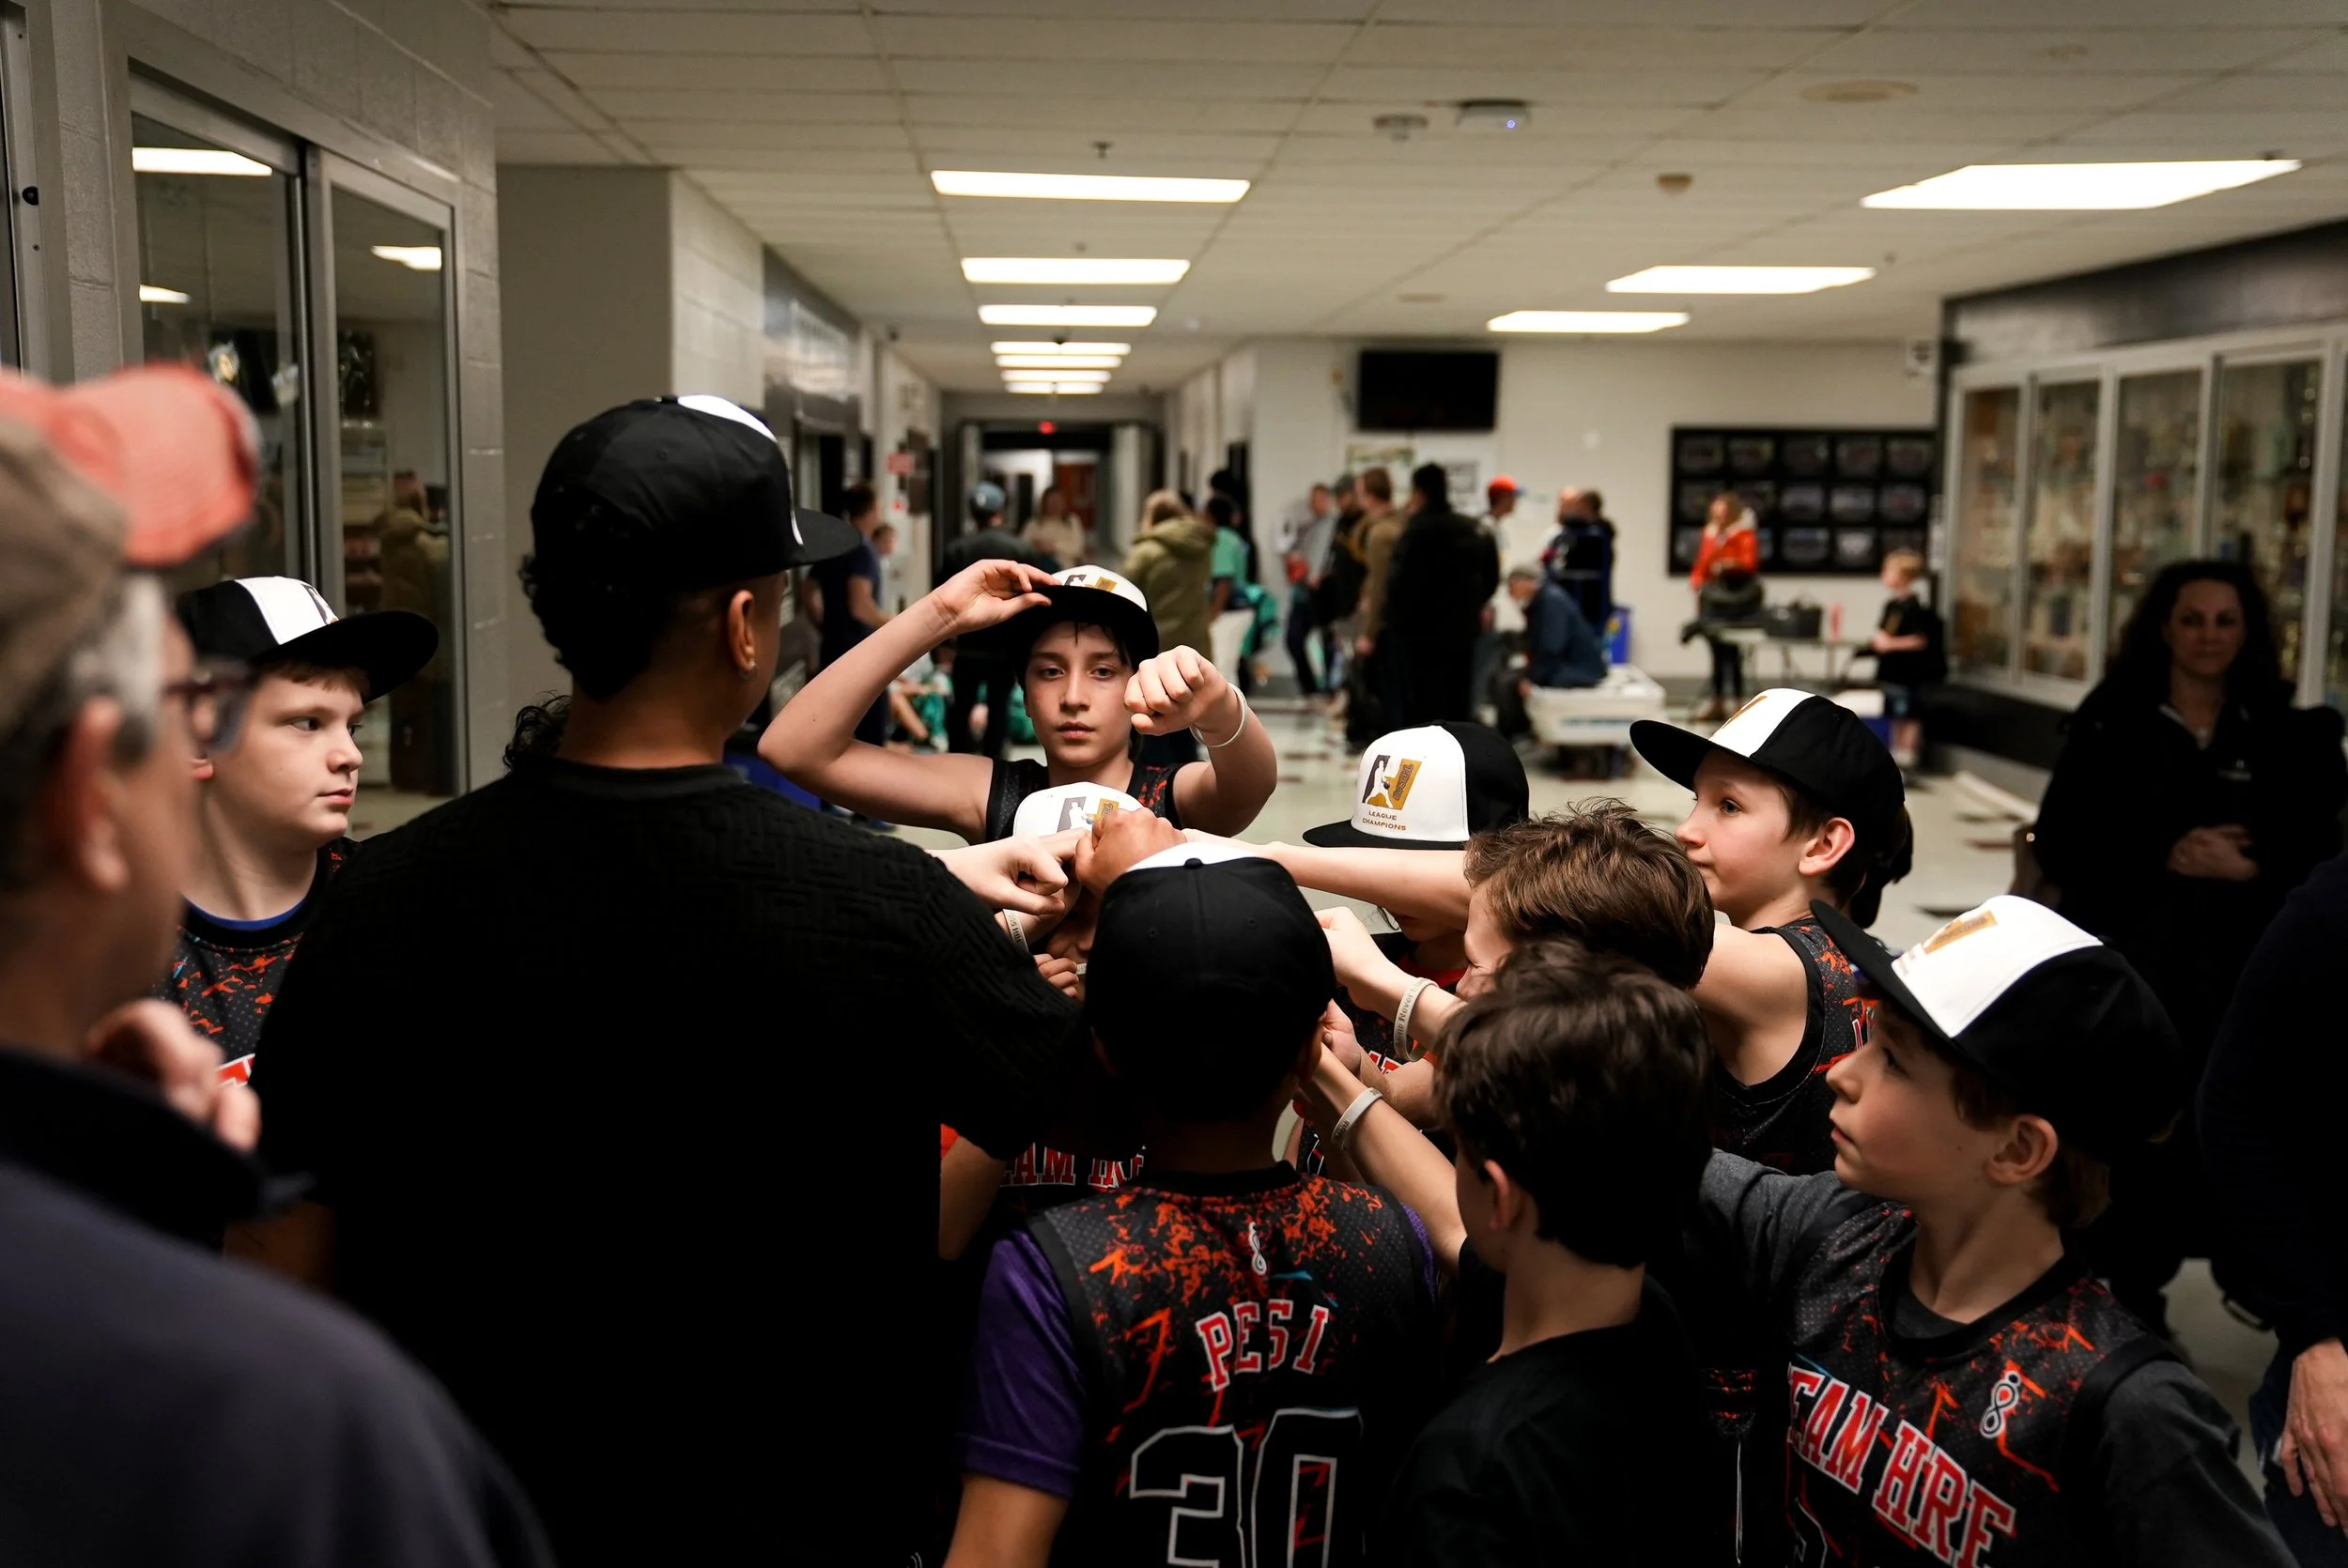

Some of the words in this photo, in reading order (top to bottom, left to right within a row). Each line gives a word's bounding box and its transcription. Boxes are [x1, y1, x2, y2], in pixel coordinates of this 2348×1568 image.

[1362, 818, 1407, 830] CHAMPIONS
[1368, 810, 1398, 821] LEAGUE
[1000, 1142, 1076, 1187] AM
[1196, 1299, 1329, 1391] PESI
[1787, 1361, 1890, 1495] EAM
